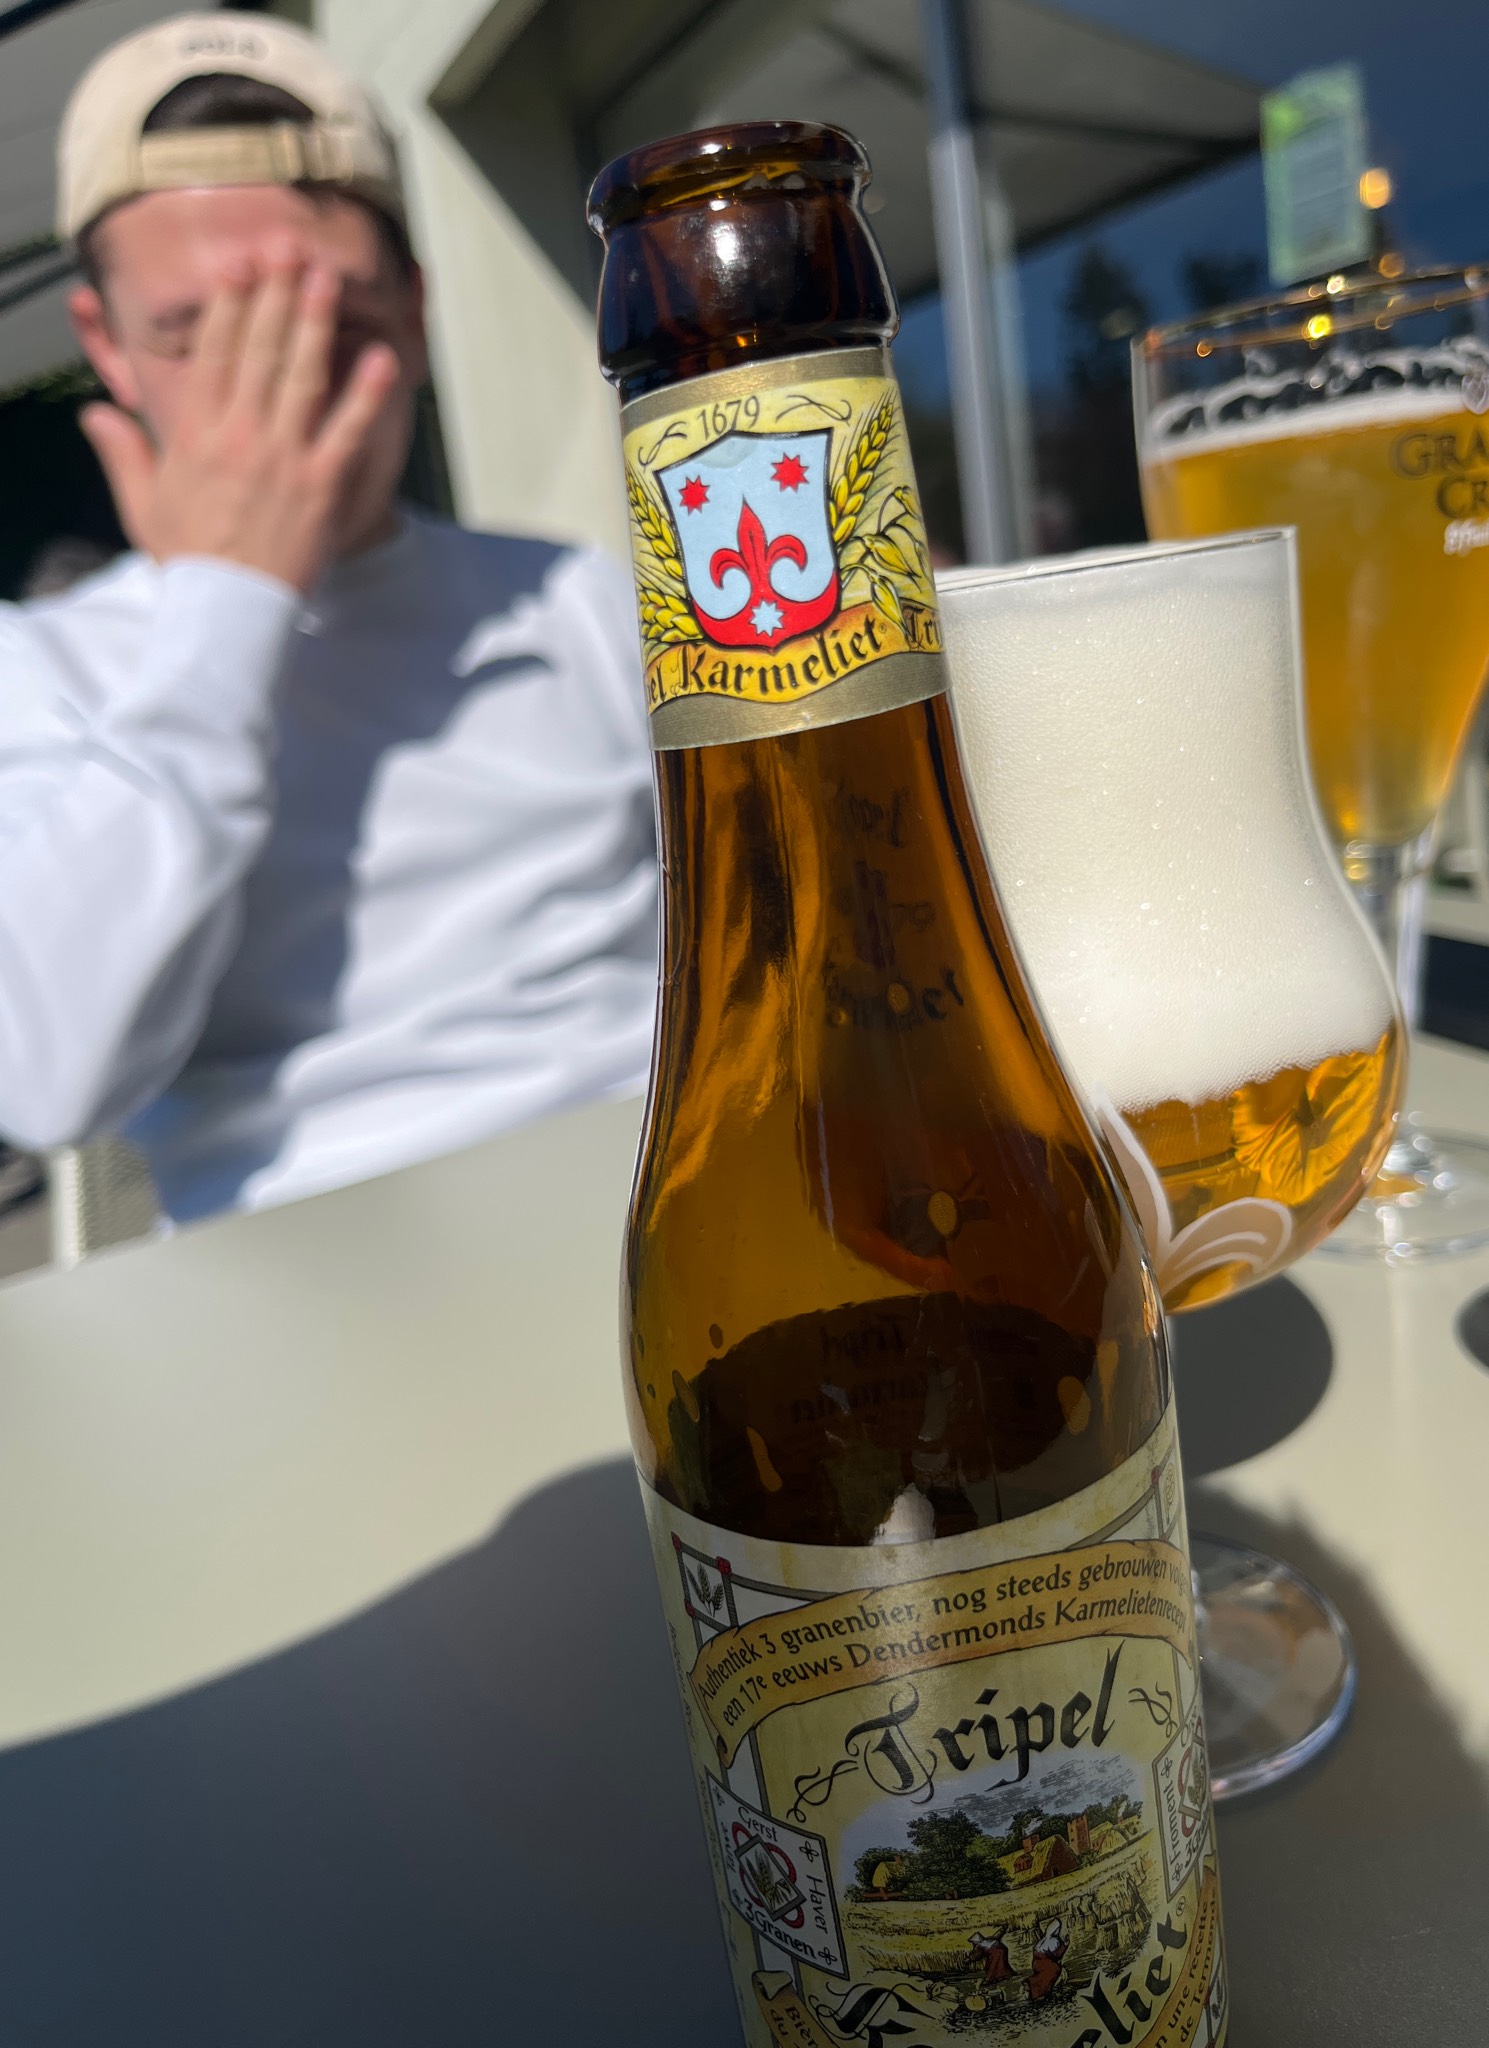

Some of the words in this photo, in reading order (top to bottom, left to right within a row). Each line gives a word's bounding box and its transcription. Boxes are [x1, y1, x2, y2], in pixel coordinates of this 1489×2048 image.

[697, 395, 761, 441] 1679
[1391, 427, 1489, 481] GRA
[1436, 473, 1489, 519] CR
[671, 614, 883, 697] Karmeliet
[903, 604, 942, 653] Tri
[698, 1637, 763, 1711] Authentiek
[759, 1633, 777, 1655] 3
[780, 1603, 922, 1655] granenbier,
[931, 1587, 988, 1615] nog
[995, 1563, 1072, 1601] steeds
[1077, 1553, 1167, 1591] gebrouwen
[722, 1702, 746, 1727] een
[739, 1674, 768, 1705] 17e
[772, 1654, 843, 1688] eeuws
[844, 1604, 1046, 1668] Dendermonds
[845, 1639, 1126, 1804] Tripel
[738, 1806, 778, 1842] Gerst
[1163, 1779, 1182, 1866] Froment
[806, 1874, 828, 1935] Haver
[769, 2009, 789, 2036] du
[784, 2005, 820, 2048] Bièr
[1167, 1984, 1191, 2029] une
[1180, 2015, 1194, 2043] de
